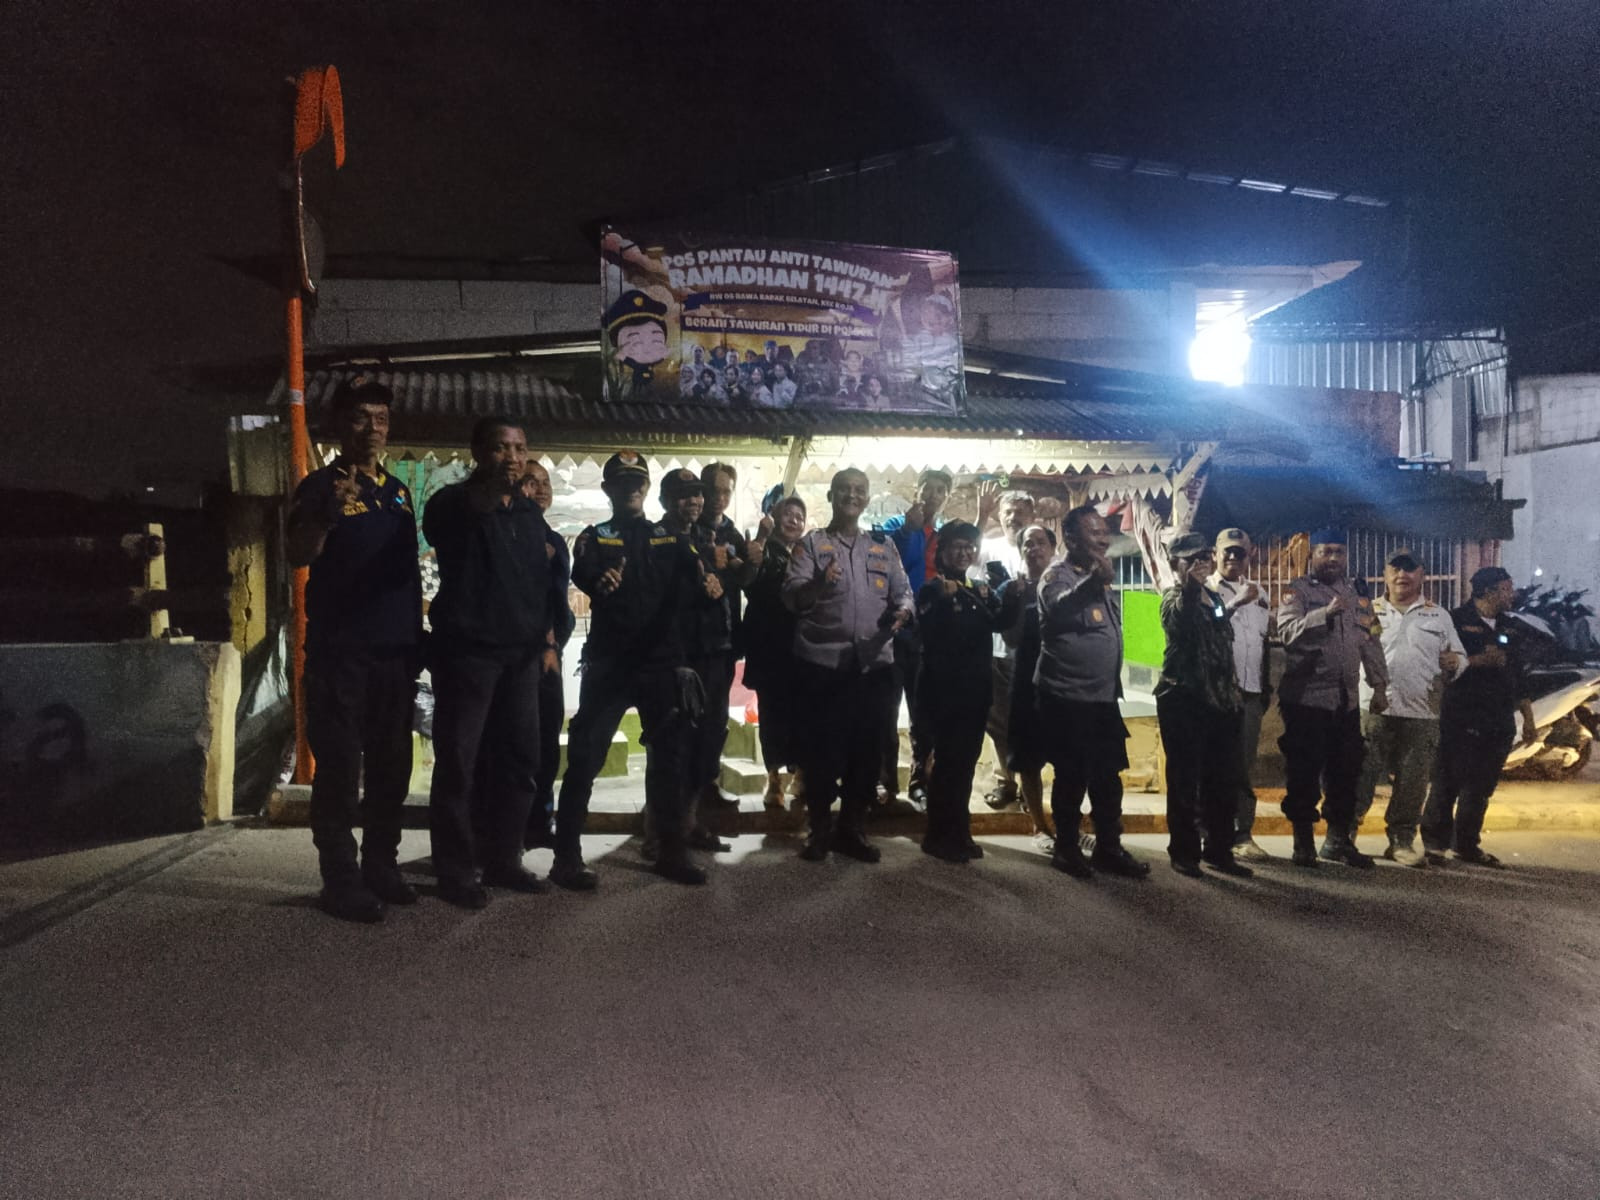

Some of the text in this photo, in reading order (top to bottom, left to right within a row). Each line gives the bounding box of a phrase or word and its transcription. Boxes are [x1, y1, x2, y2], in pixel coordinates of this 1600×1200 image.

[661, 249, 894, 289] POS PANTAU ANTI TAWURAN
[668, 265, 809, 289] RAMADHAN
[814, 273, 866, 303] 1447
[787, 322, 819, 334] TIDUR
[821, 324, 832, 335] DI
